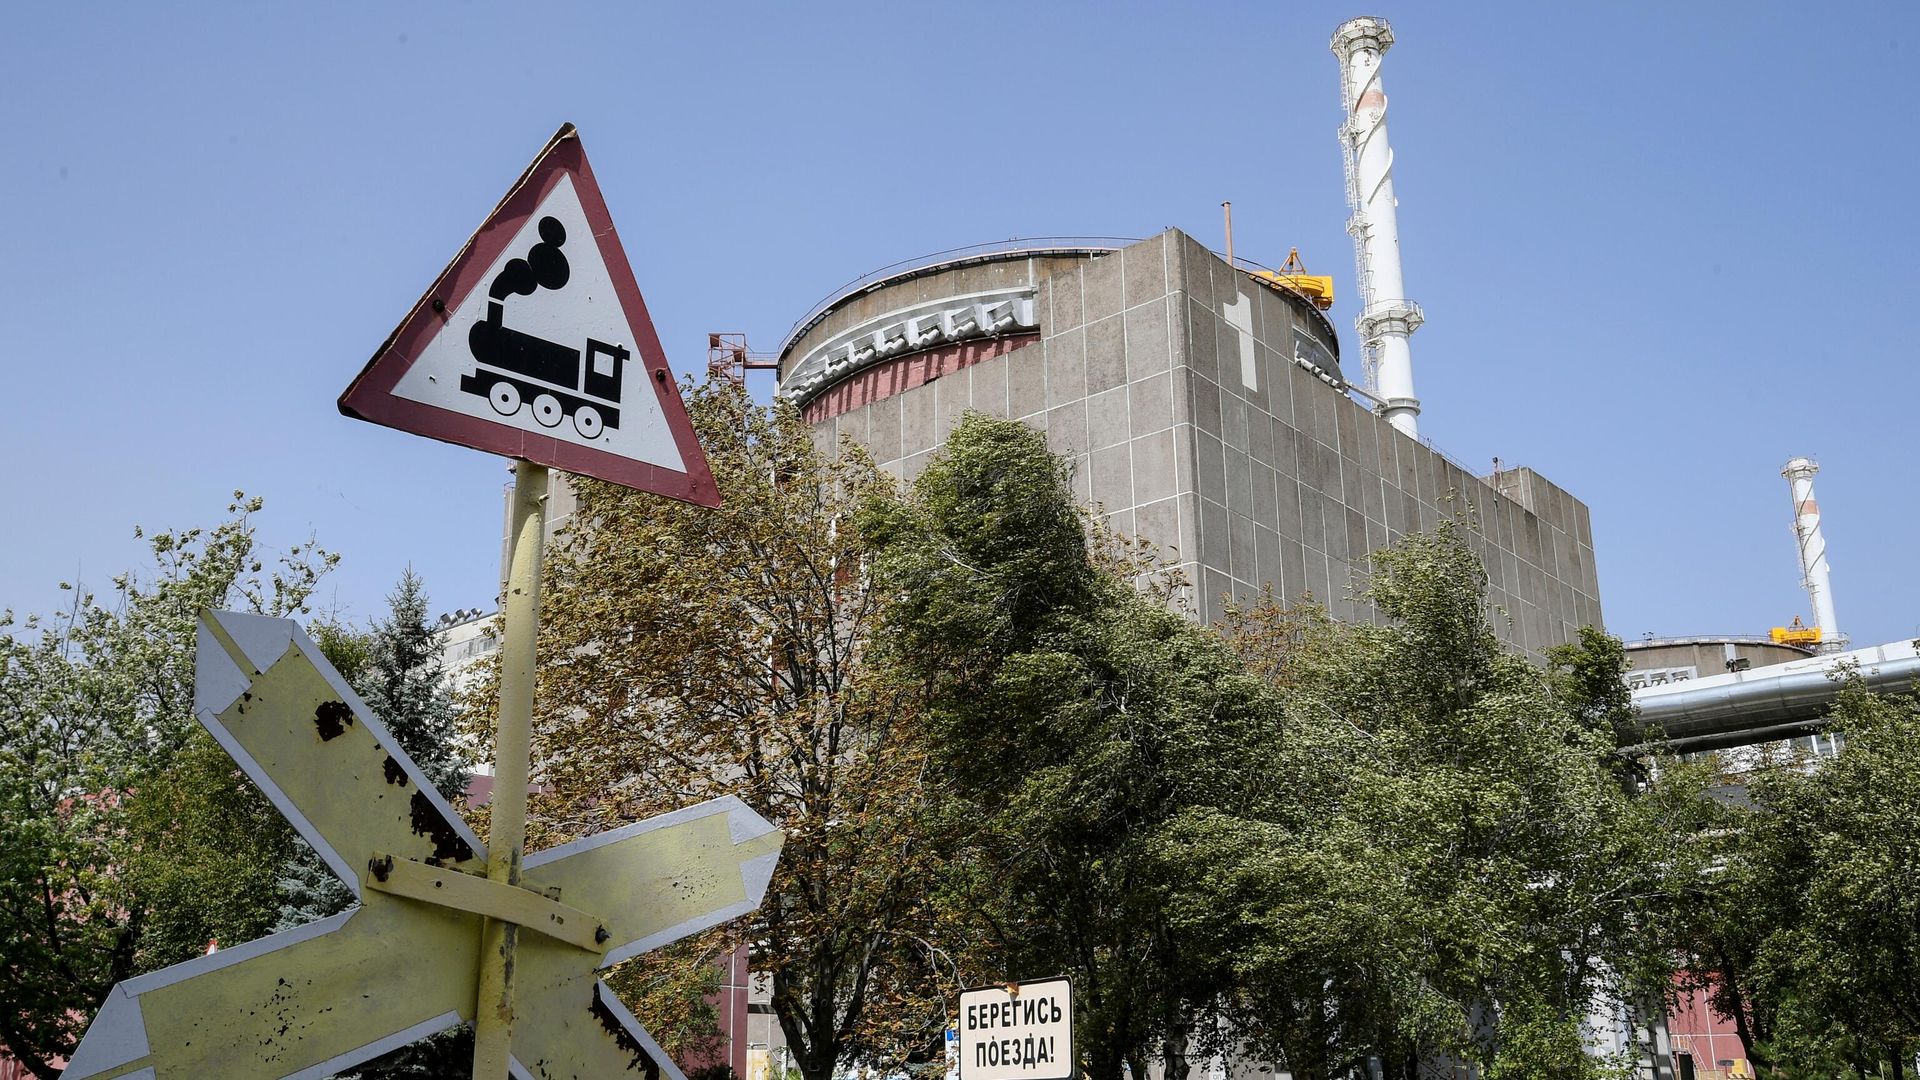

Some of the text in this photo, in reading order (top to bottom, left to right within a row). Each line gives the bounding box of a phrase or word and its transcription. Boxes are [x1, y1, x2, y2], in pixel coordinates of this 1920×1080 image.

[1223, 291, 1258, 393] 1
[968, 997, 1062, 1030] БЕРЕГИСЬ
[976, 1036, 1054, 1070] ПОЕЗДА!
